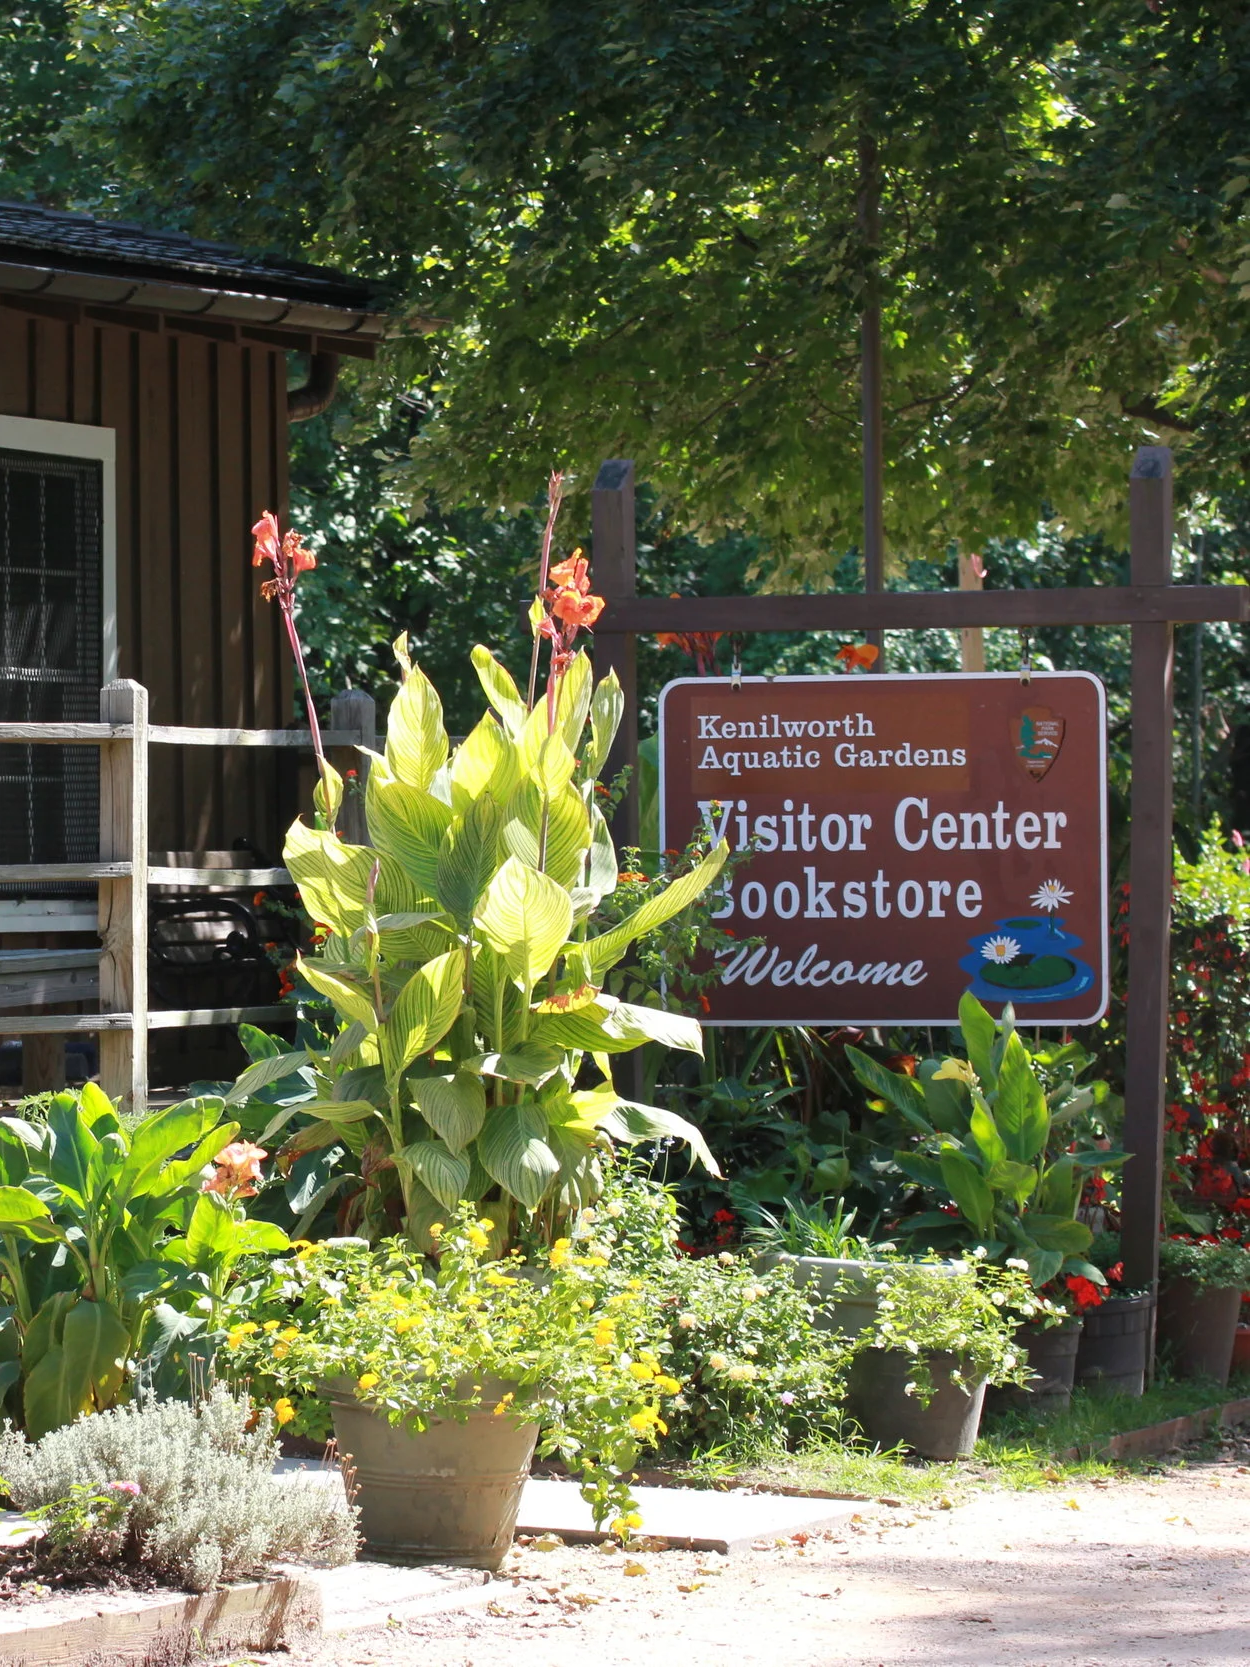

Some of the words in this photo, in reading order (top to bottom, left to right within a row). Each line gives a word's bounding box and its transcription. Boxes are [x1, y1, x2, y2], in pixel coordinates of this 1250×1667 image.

[697, 713, 875, 739] Kenilworth
[697, 745, 820, 776] Aquatic
[834, 743, 967, 768] Gardens
[697, 799, 873, 852] Visitor
[894, 797, 1068, 851] Center
[714, 943, 928, 987] Welcome
